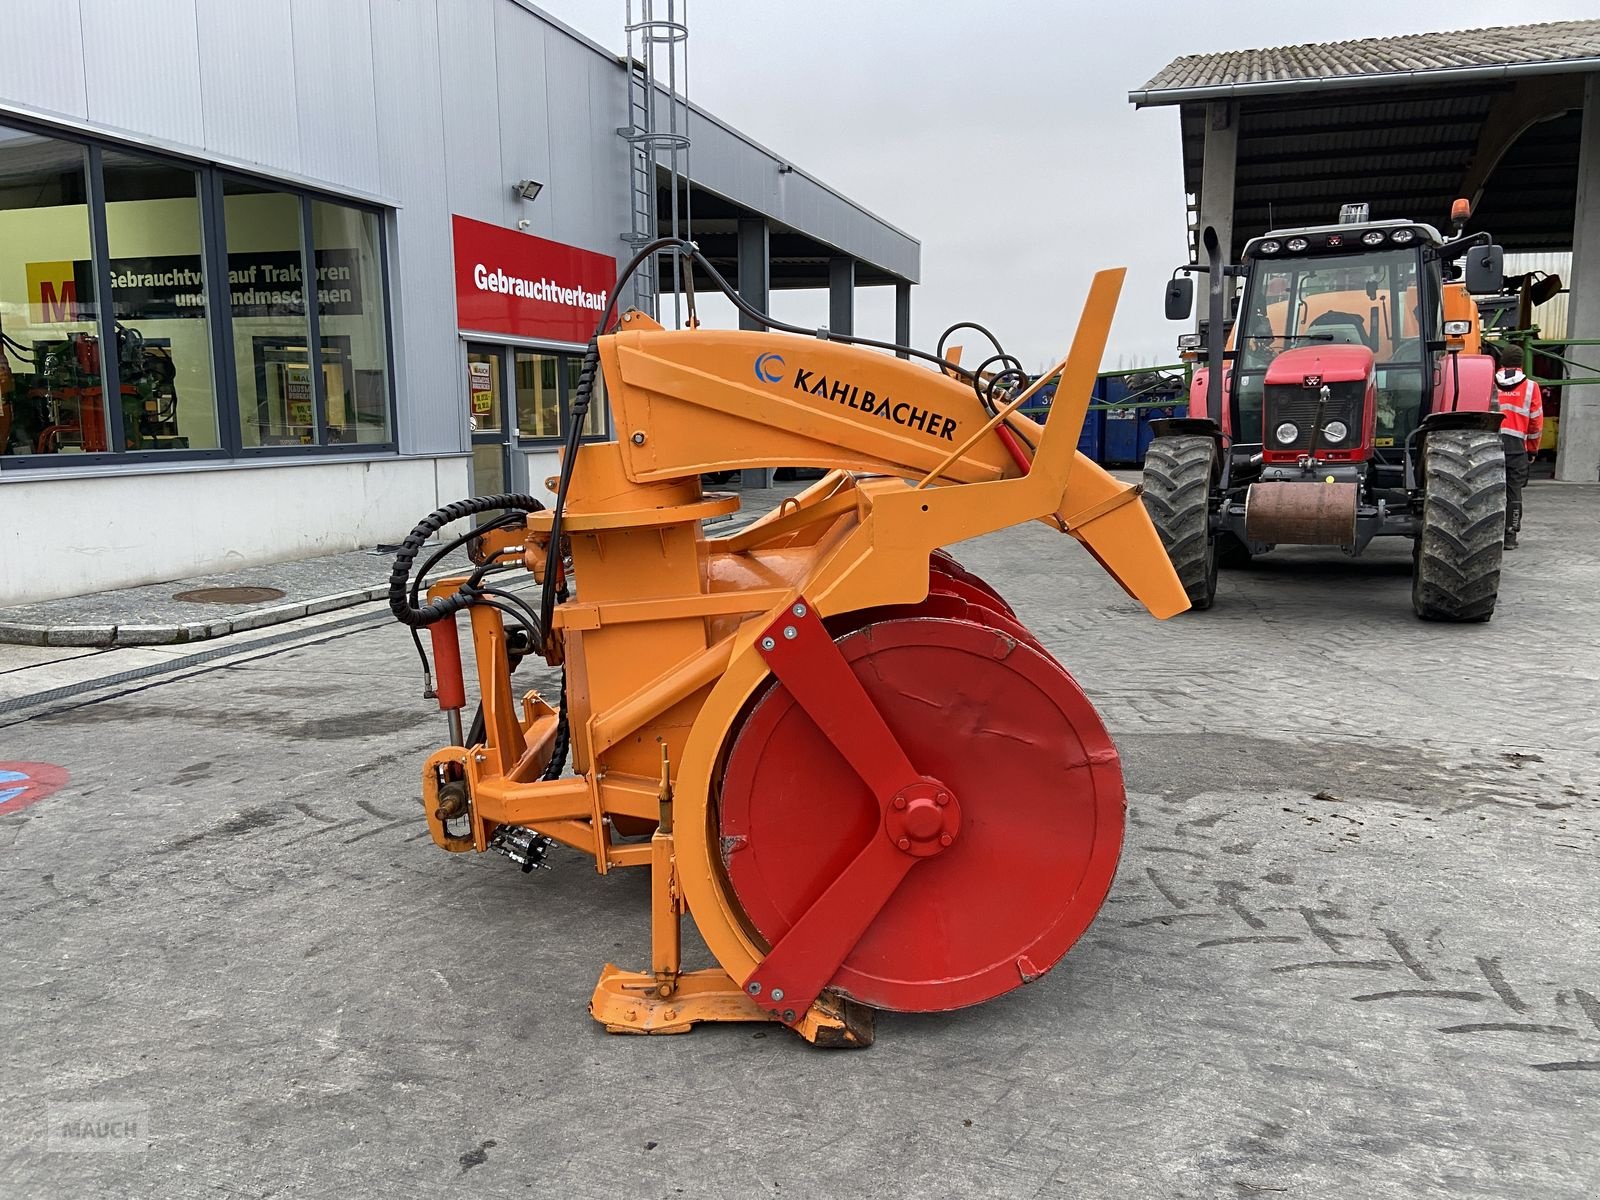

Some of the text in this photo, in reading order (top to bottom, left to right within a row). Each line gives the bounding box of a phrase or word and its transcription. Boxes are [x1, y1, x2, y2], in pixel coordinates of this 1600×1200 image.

[110, 265, 257, 288] Gebrauchtvauf
[474, 264, 607, 311] Gebrauchtverkauf
[793, 368, 957, 441] KAHLBACHER
